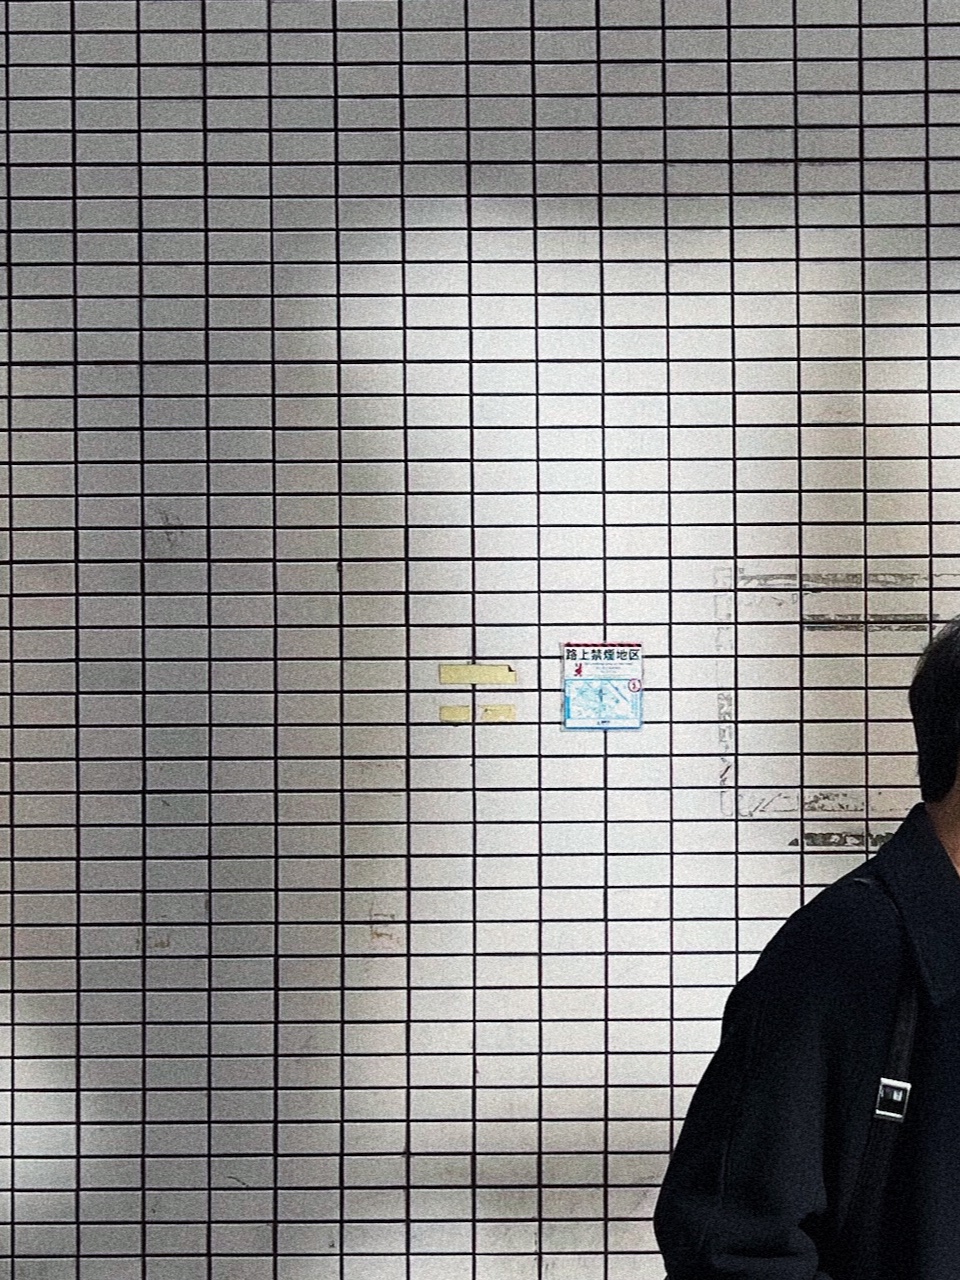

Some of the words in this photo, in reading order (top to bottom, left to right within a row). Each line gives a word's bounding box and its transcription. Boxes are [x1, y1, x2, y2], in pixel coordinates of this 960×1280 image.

[566, 649, 640, 660] 路上禁煙地区
